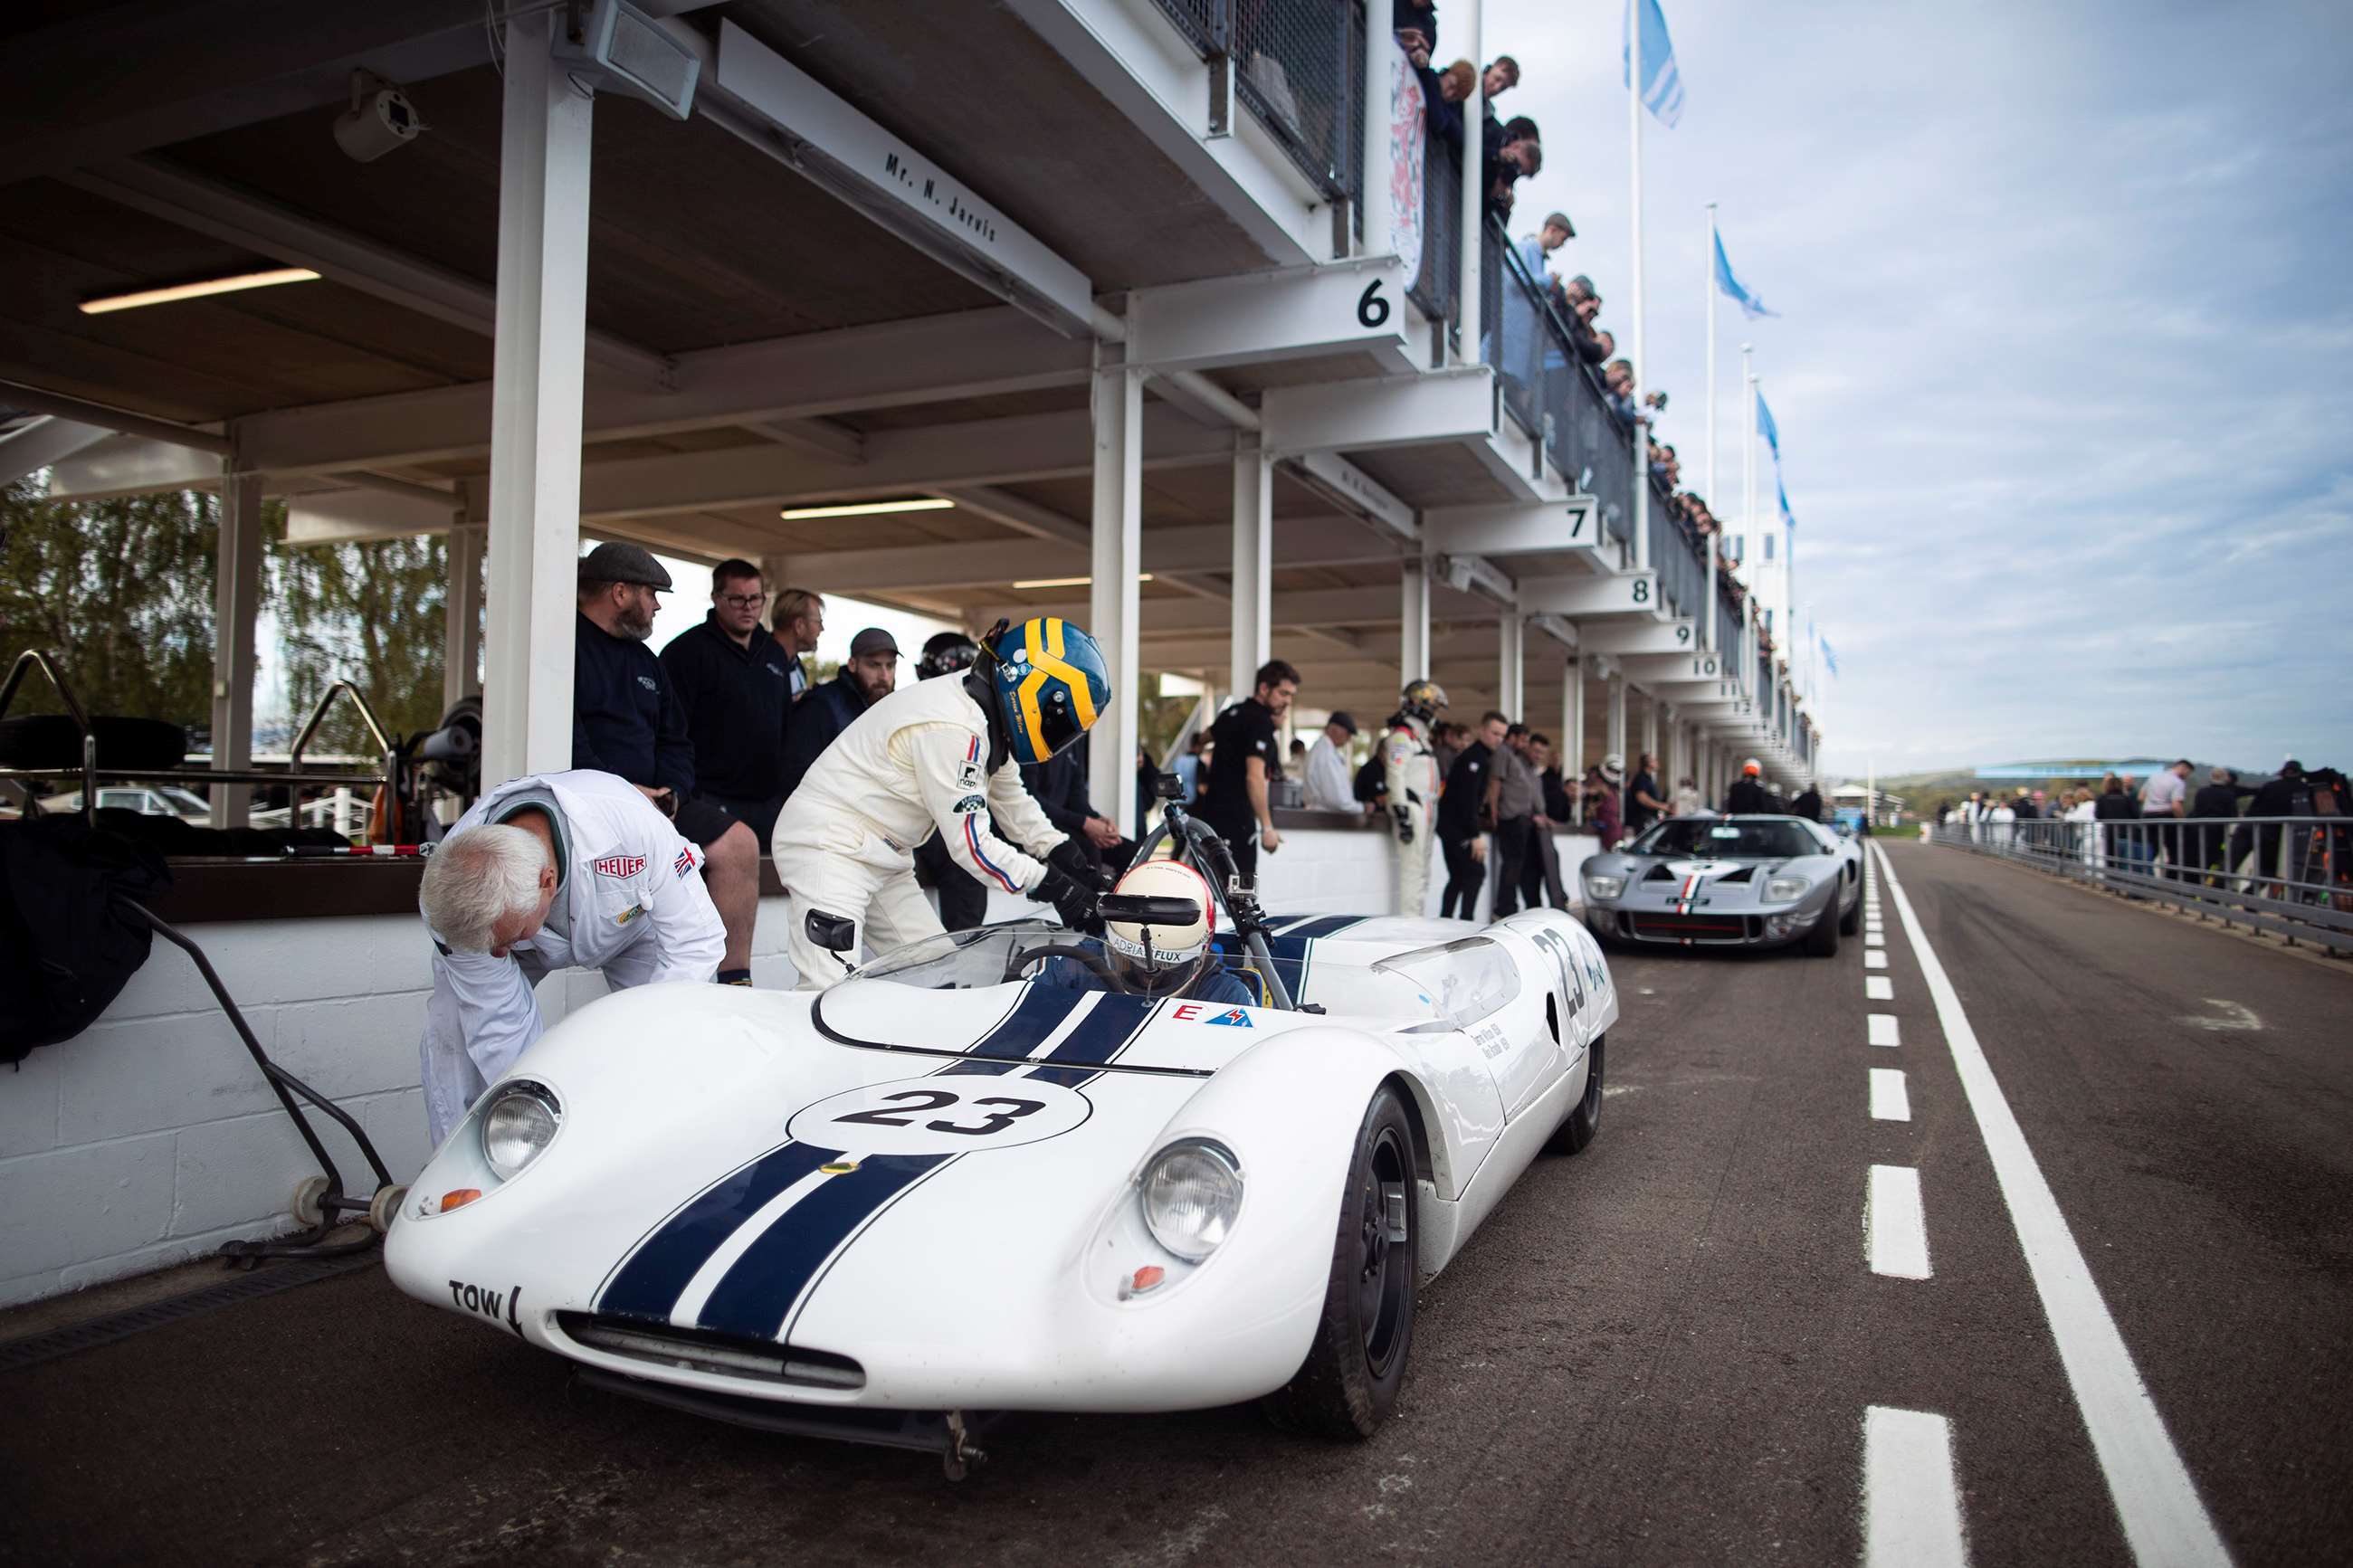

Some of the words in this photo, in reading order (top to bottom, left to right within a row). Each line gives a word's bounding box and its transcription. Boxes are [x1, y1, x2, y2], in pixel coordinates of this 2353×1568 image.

[885, 152, 912, 187] Mr.
[923, 179, 939, 205] N.
[948, 196, 996, 242] Jarvis
[1358, 278, 1390, 328] 6
[1567, 508, 1587, 537] 7
[1633, 578, 1648, 603] 8
[1676, 625, 1690, 645] 9
[1693, 659, 1716, 675] 10
[598, 858, 644, 878] HEUER
[1114, 937, 1153, 957] ADRIA
[1154, 950, 1181, 962] FLUX
[1172, 1004, 1203, 1022] E
[830, 1089, 1046, 1136] 23
[449, 1279, 503, 1319] TOW
